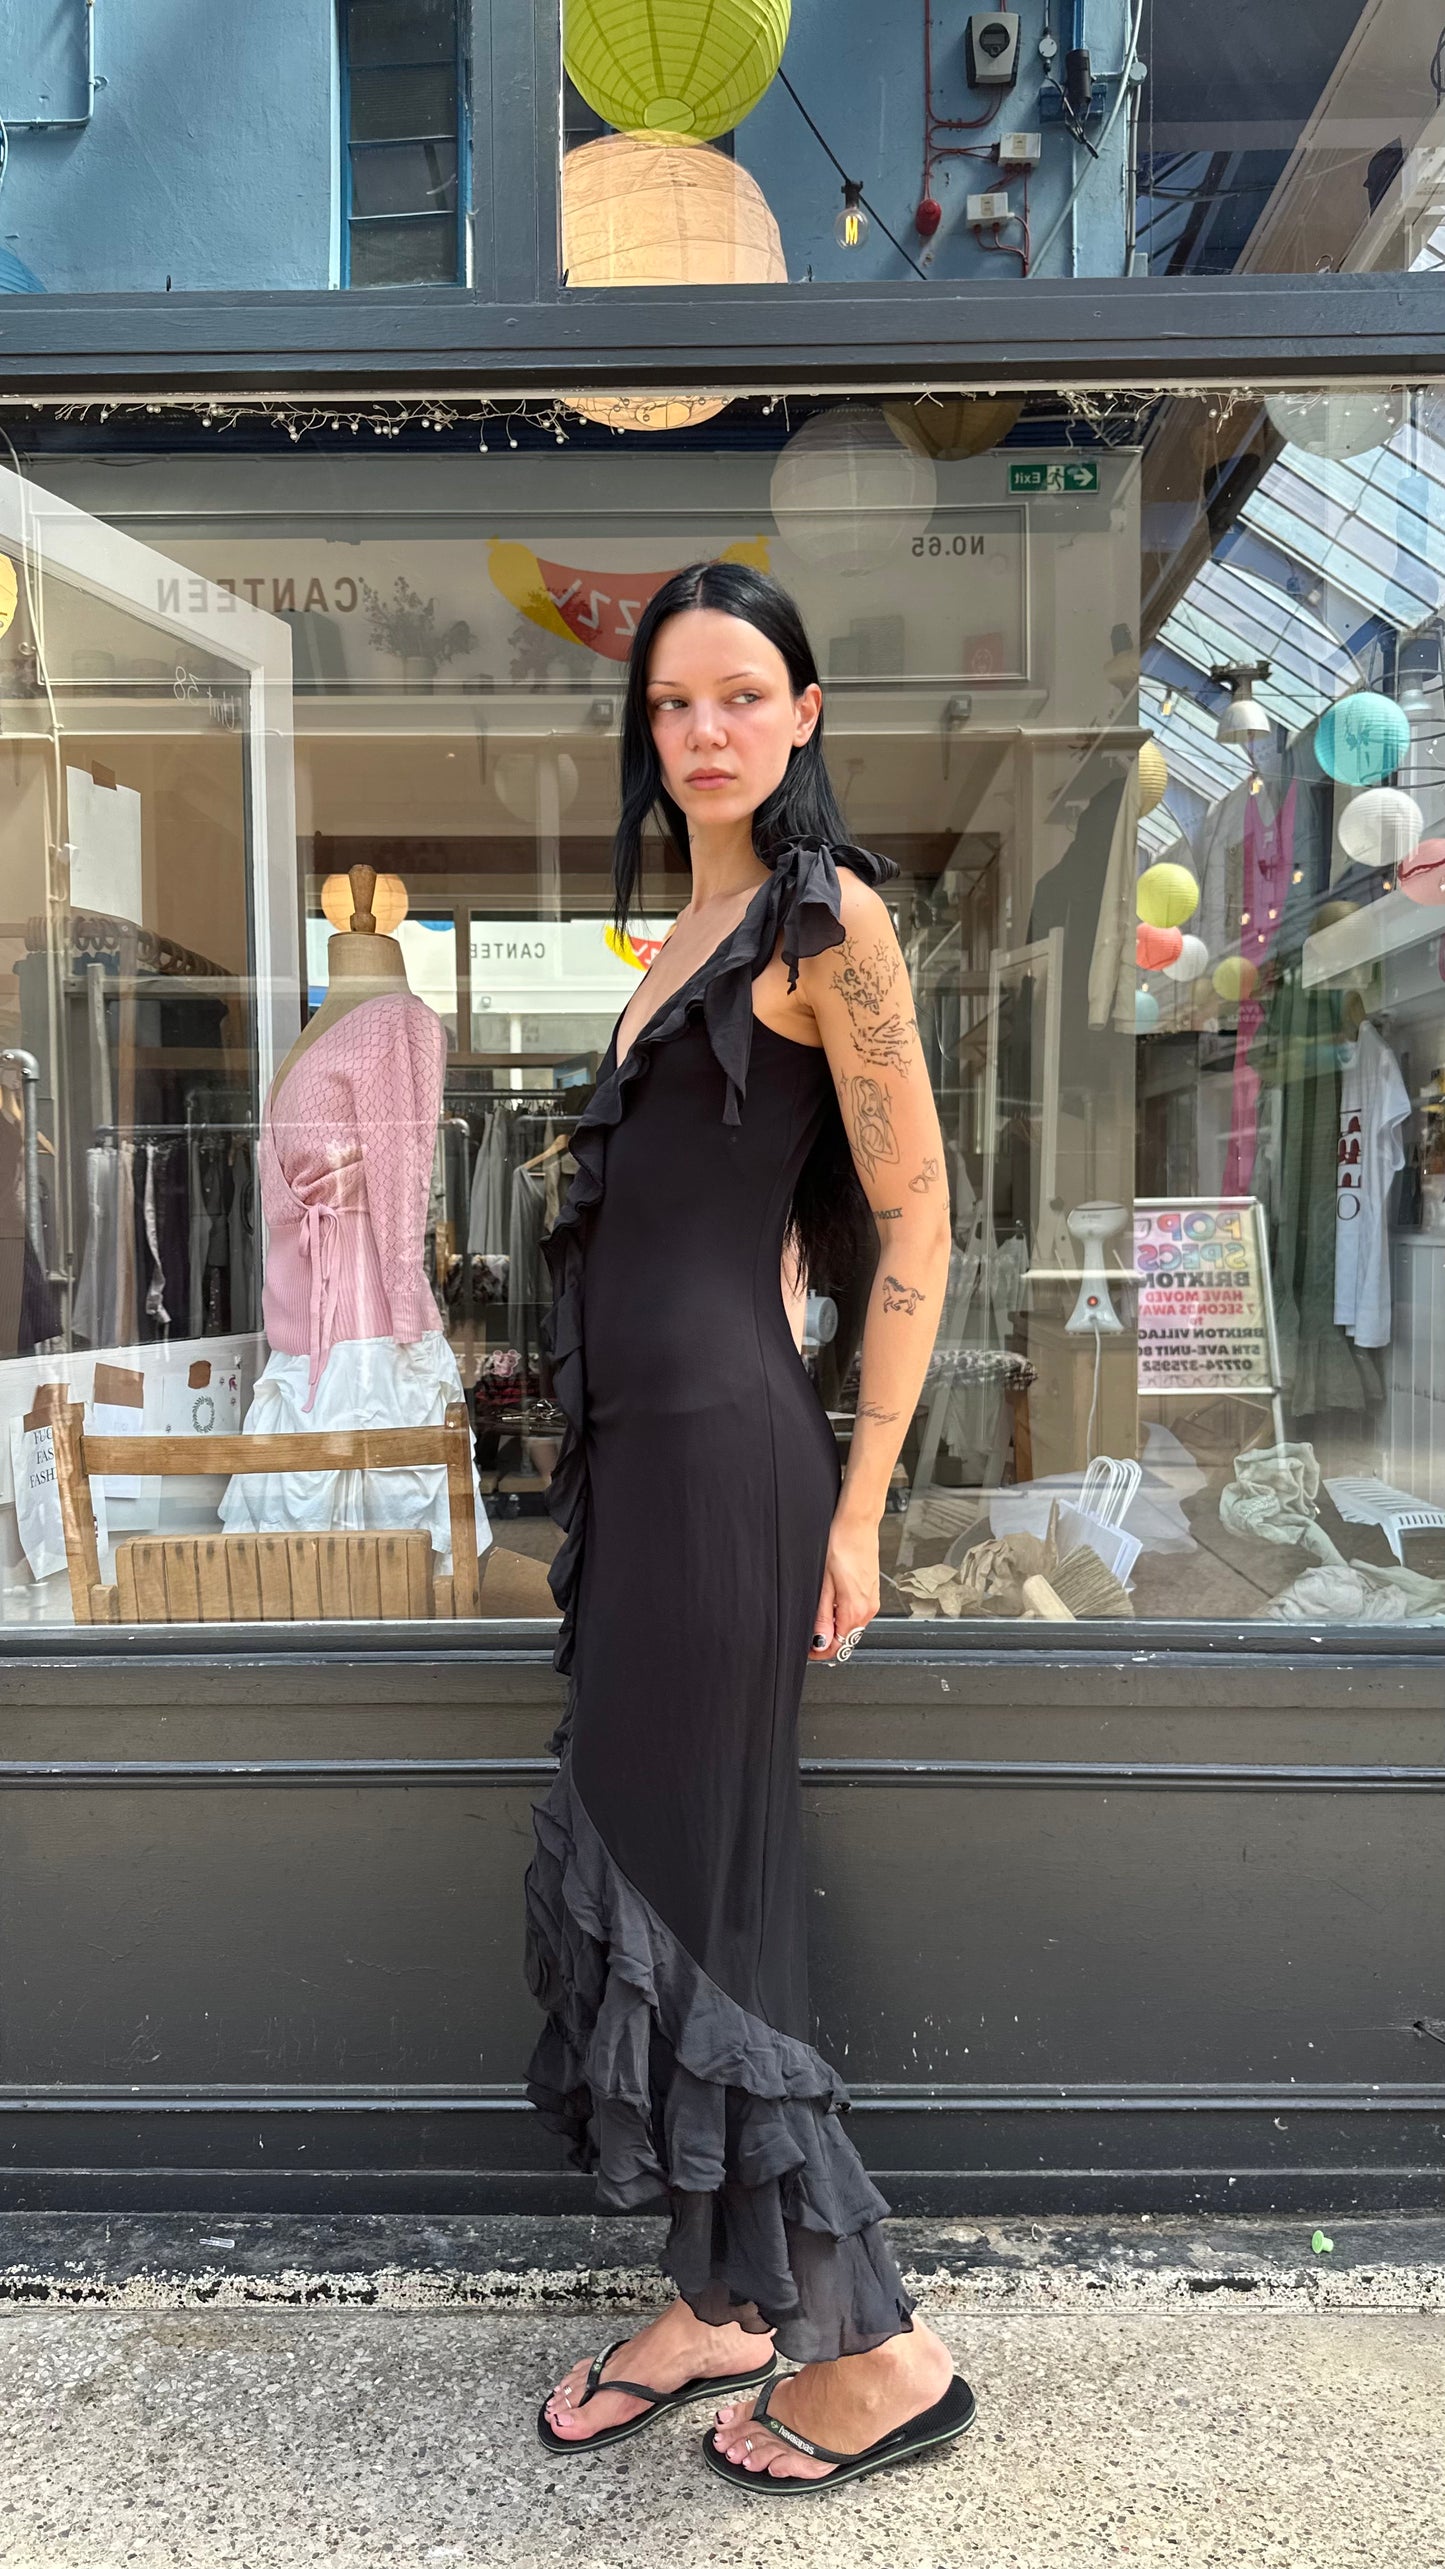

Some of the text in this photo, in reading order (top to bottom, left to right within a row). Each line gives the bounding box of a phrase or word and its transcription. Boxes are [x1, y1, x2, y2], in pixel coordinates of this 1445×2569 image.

[33, 1427, 53, 1445] FUC
[36, 1447, 54, 1465] FAS
[29, 1467, 58, 1488] FASH
